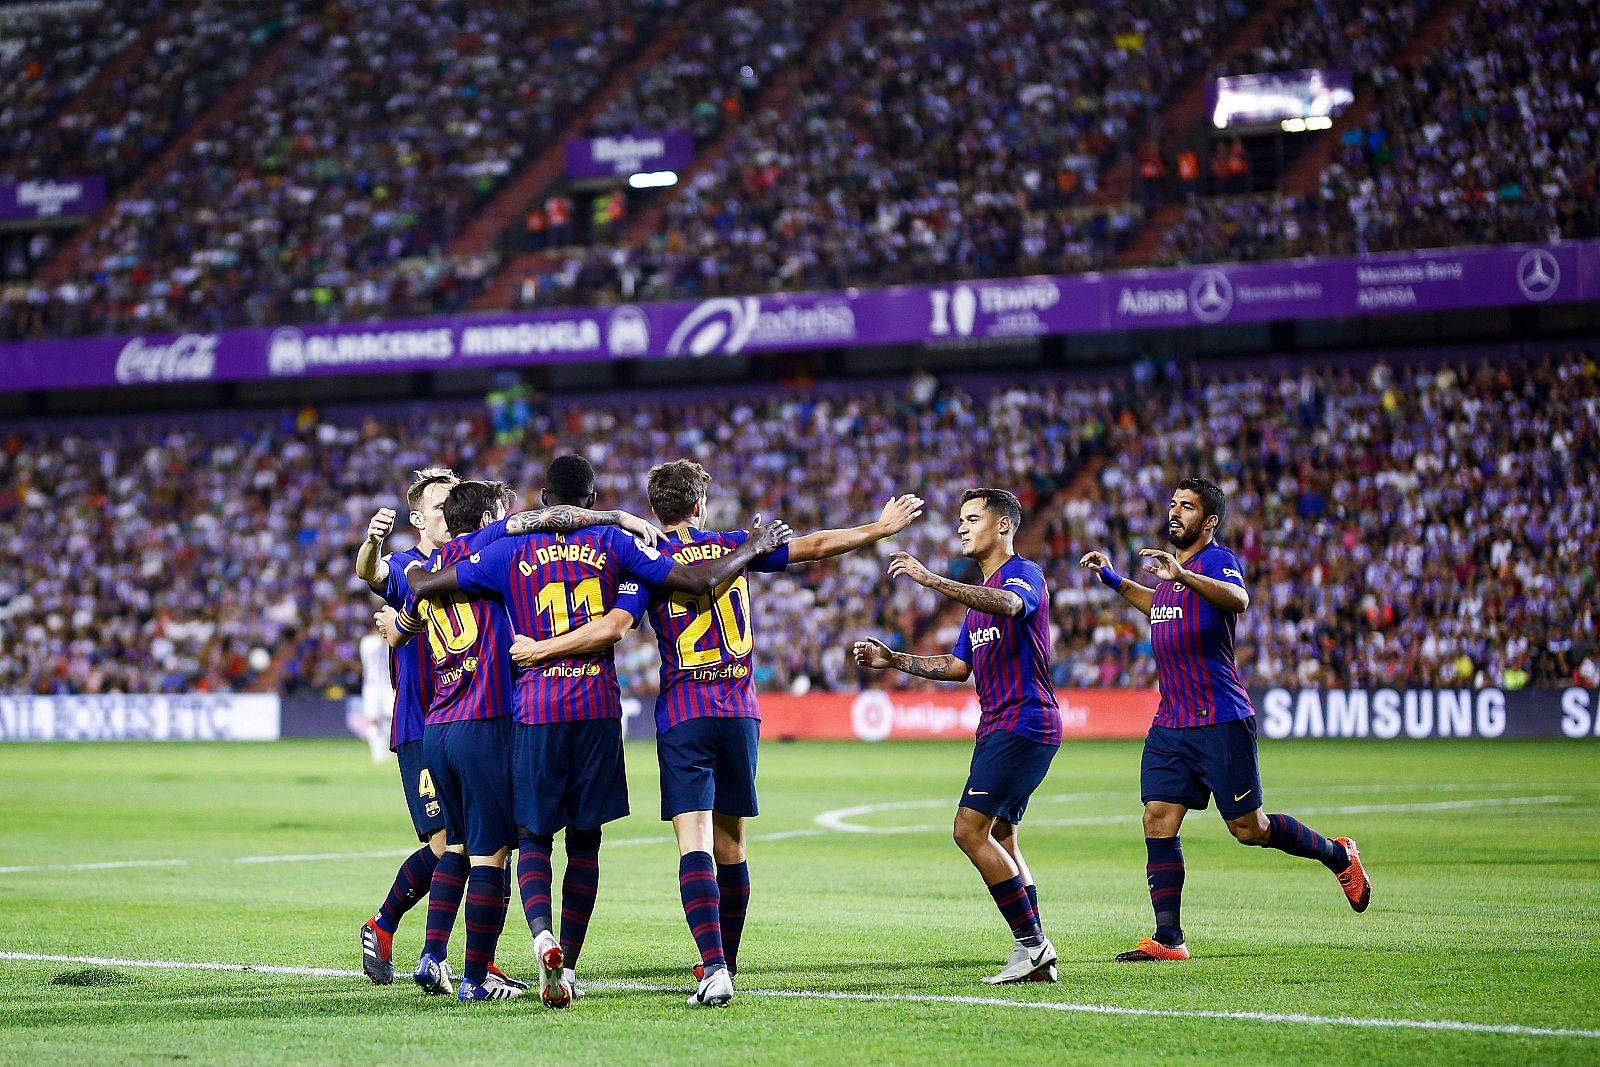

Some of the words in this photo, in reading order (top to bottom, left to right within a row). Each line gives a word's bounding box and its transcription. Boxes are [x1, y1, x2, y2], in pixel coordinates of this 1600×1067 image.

[461, 319, 599, 356] MINGUELA
[535, 543, 607, 571] DEMBÉLÉ
[671, 543, 736, 566] ROBERT
[618, 581, 639, 595] eko
[534, 576, 605, 638] 11
[667, 574, 753, 670] 20
[1150, 603, 1184, 624] kuten
[417, 591, 479, 665] 10
[542, 662, 587, 678] unicef
[1262, 687, 1507, 738] SAMSUNG
[418, 768, 437, 799] 4
